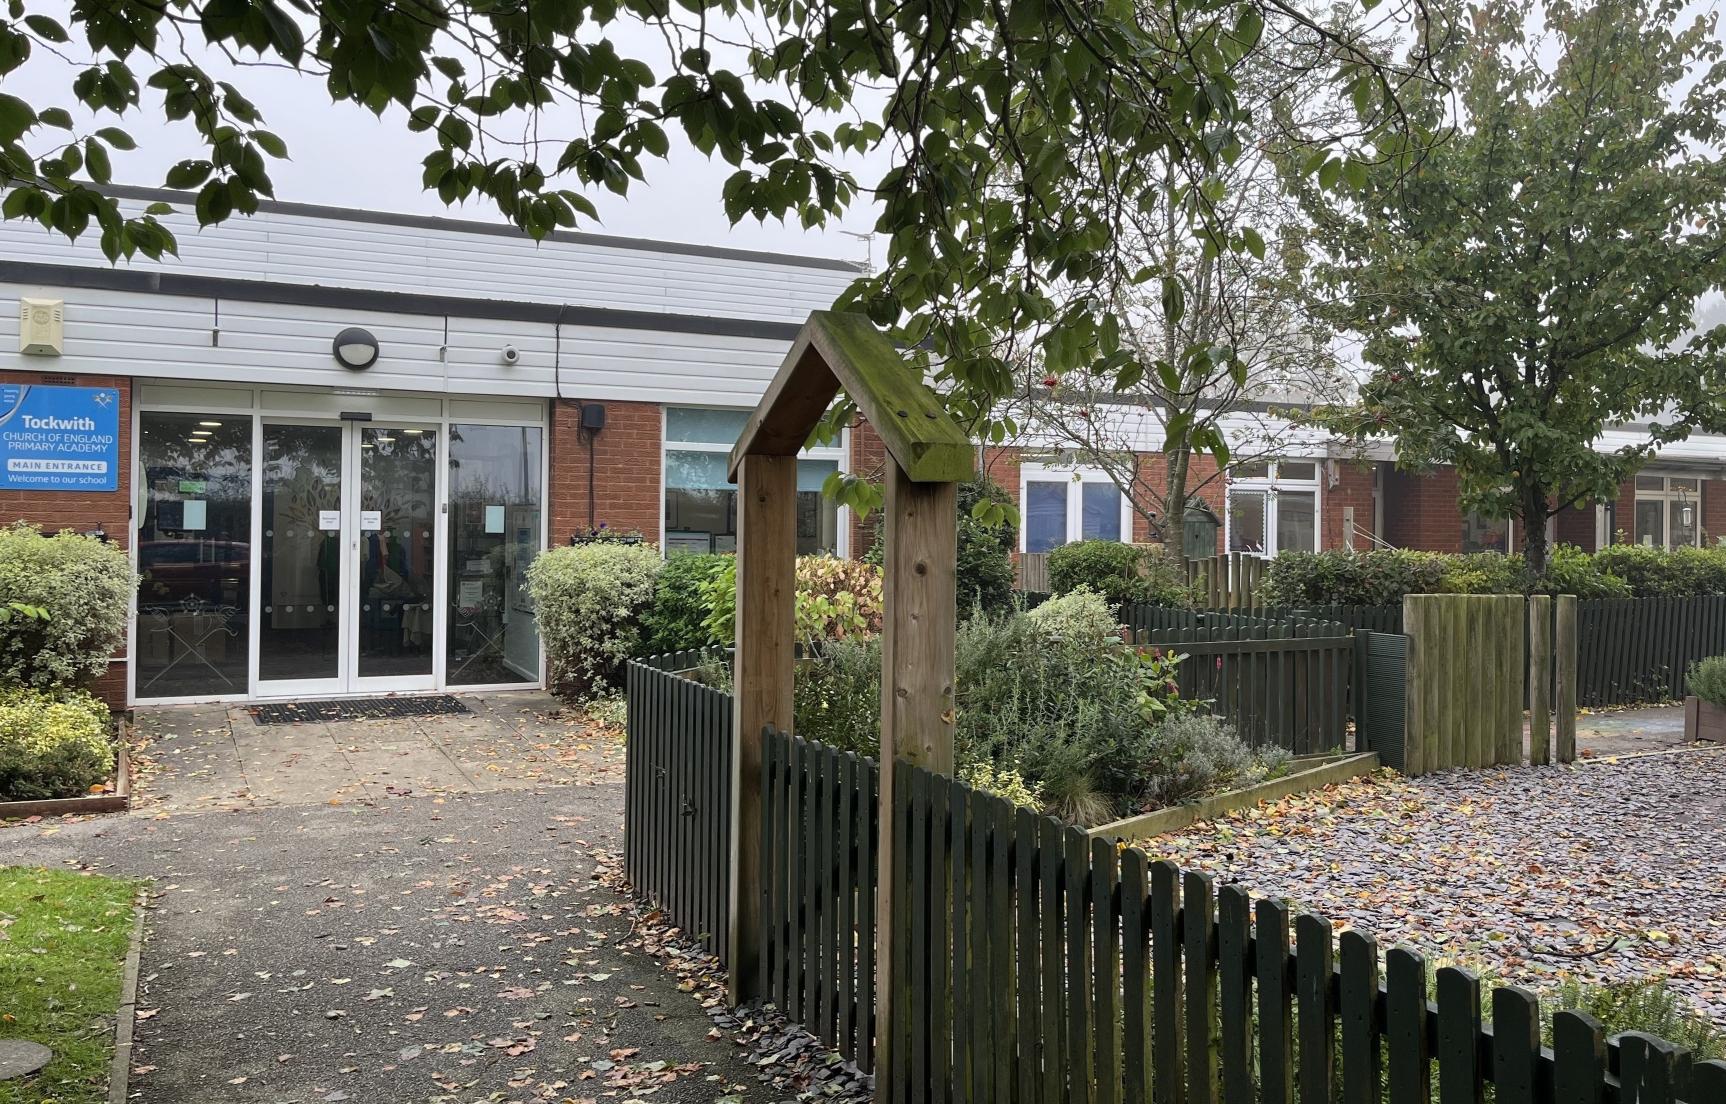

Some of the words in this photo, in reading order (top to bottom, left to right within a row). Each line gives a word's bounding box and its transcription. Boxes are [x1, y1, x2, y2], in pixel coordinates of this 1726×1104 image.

[22, 415, 95, 431] Tockwith
[3, 431, 46, 442] CHURCH
[48, 433, 61, 442] OF
[64, 434, 113, 444] ENGLAND
[57, 443, 108, 453] ACADEMY
[13, 461, 42, 469] MAIN
[46, 462, 103, 470] ENTRANCE
[8, 474, 49, 483] Welcome
[79, 476, 107, 484] school
